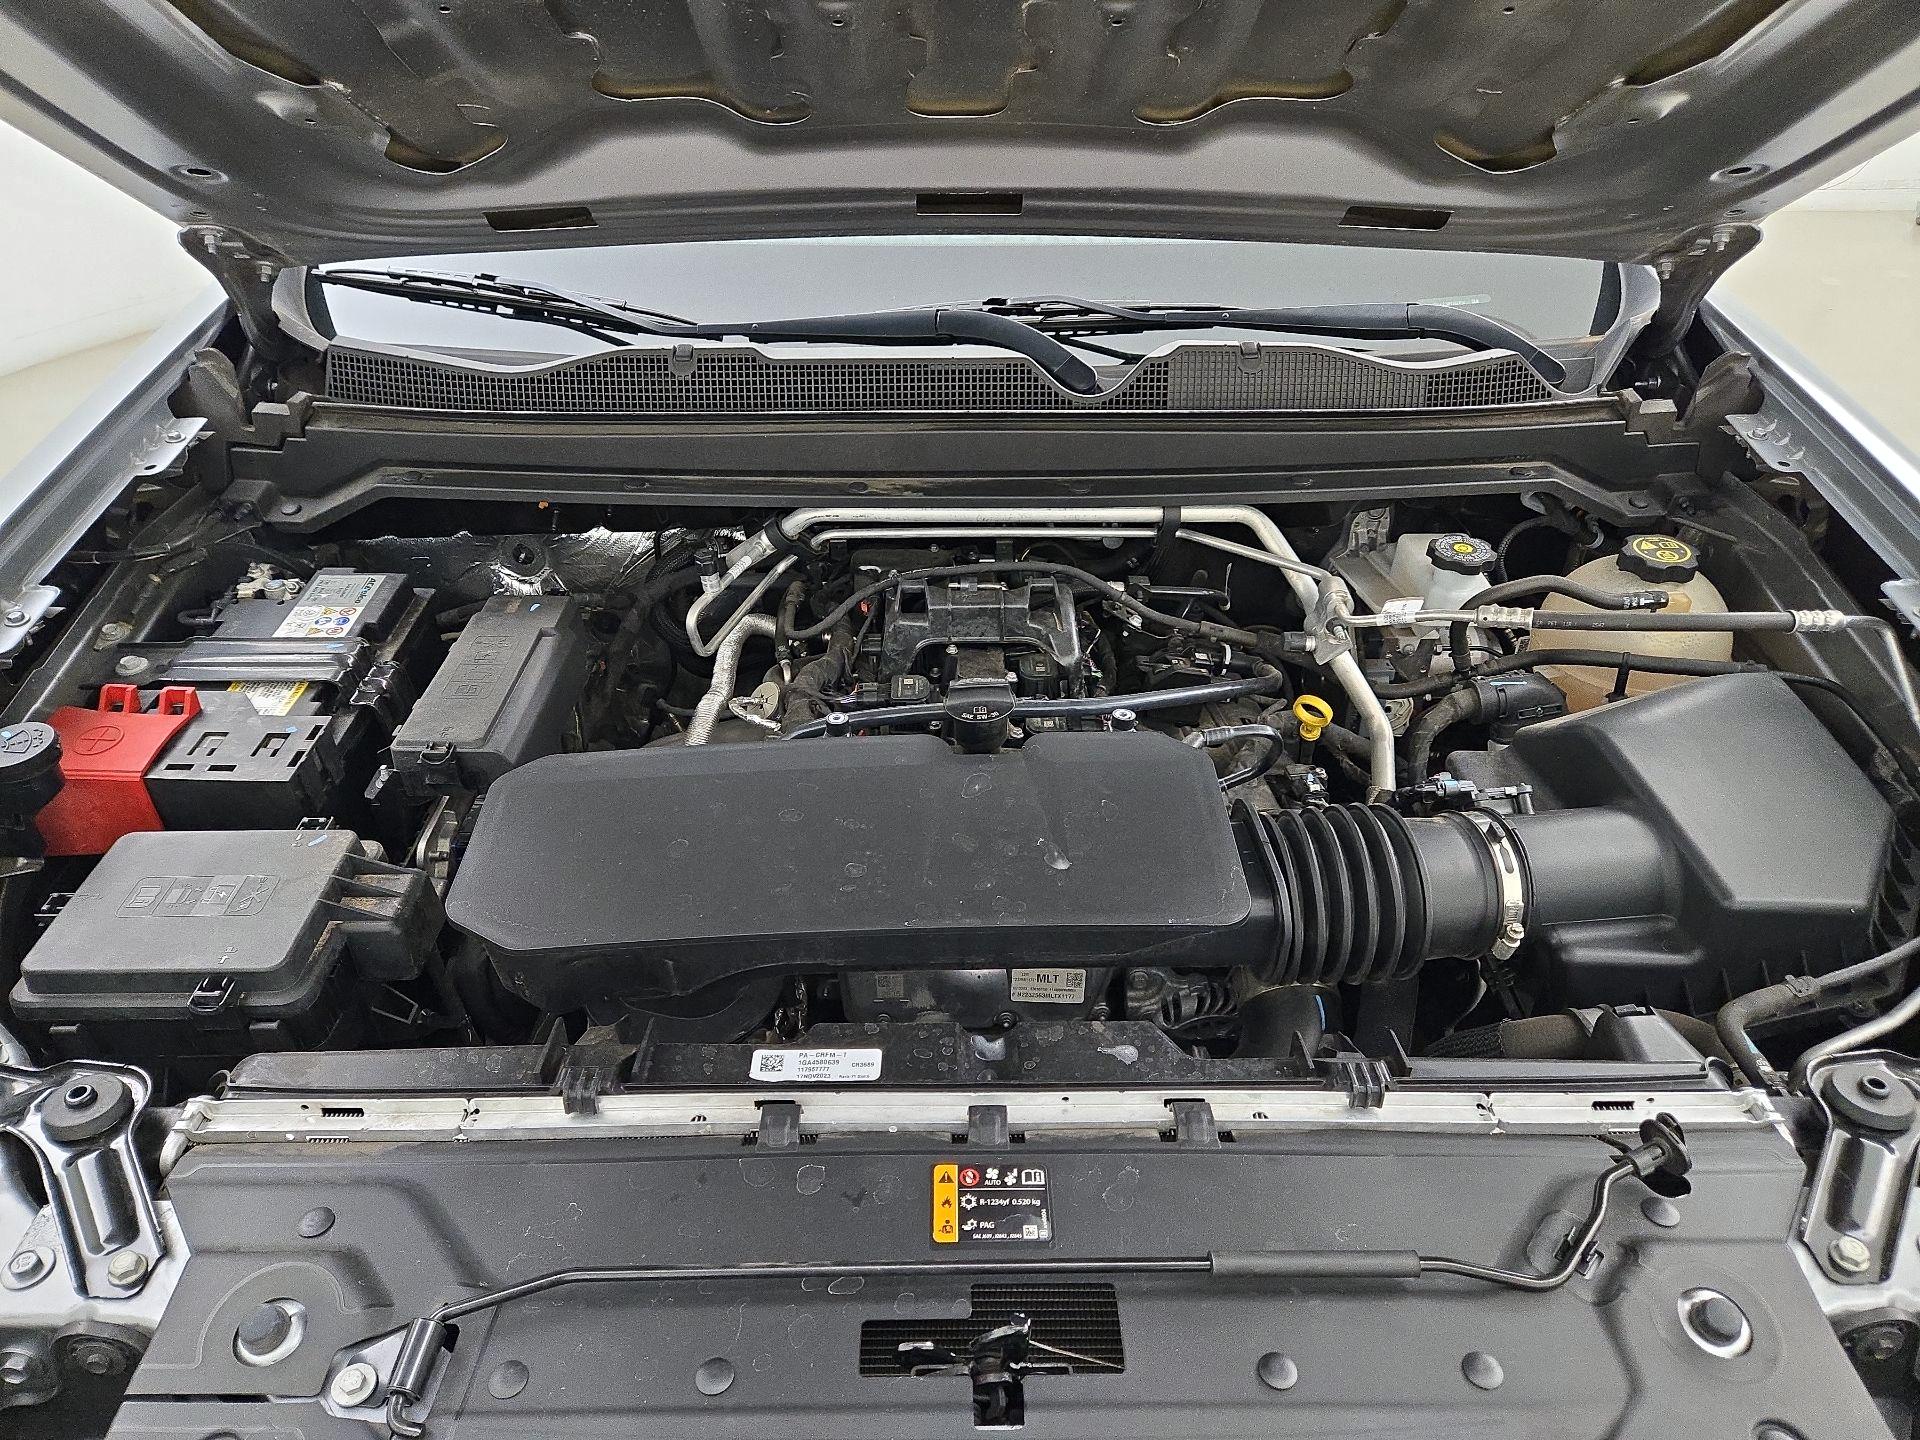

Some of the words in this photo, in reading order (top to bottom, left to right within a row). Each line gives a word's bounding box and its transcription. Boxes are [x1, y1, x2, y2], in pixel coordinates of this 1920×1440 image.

[1036, 973, 1060, 984] MLT
[1031, 1198, 1041, 1207] kg
[979, 1221, 995, 1229] PAG
